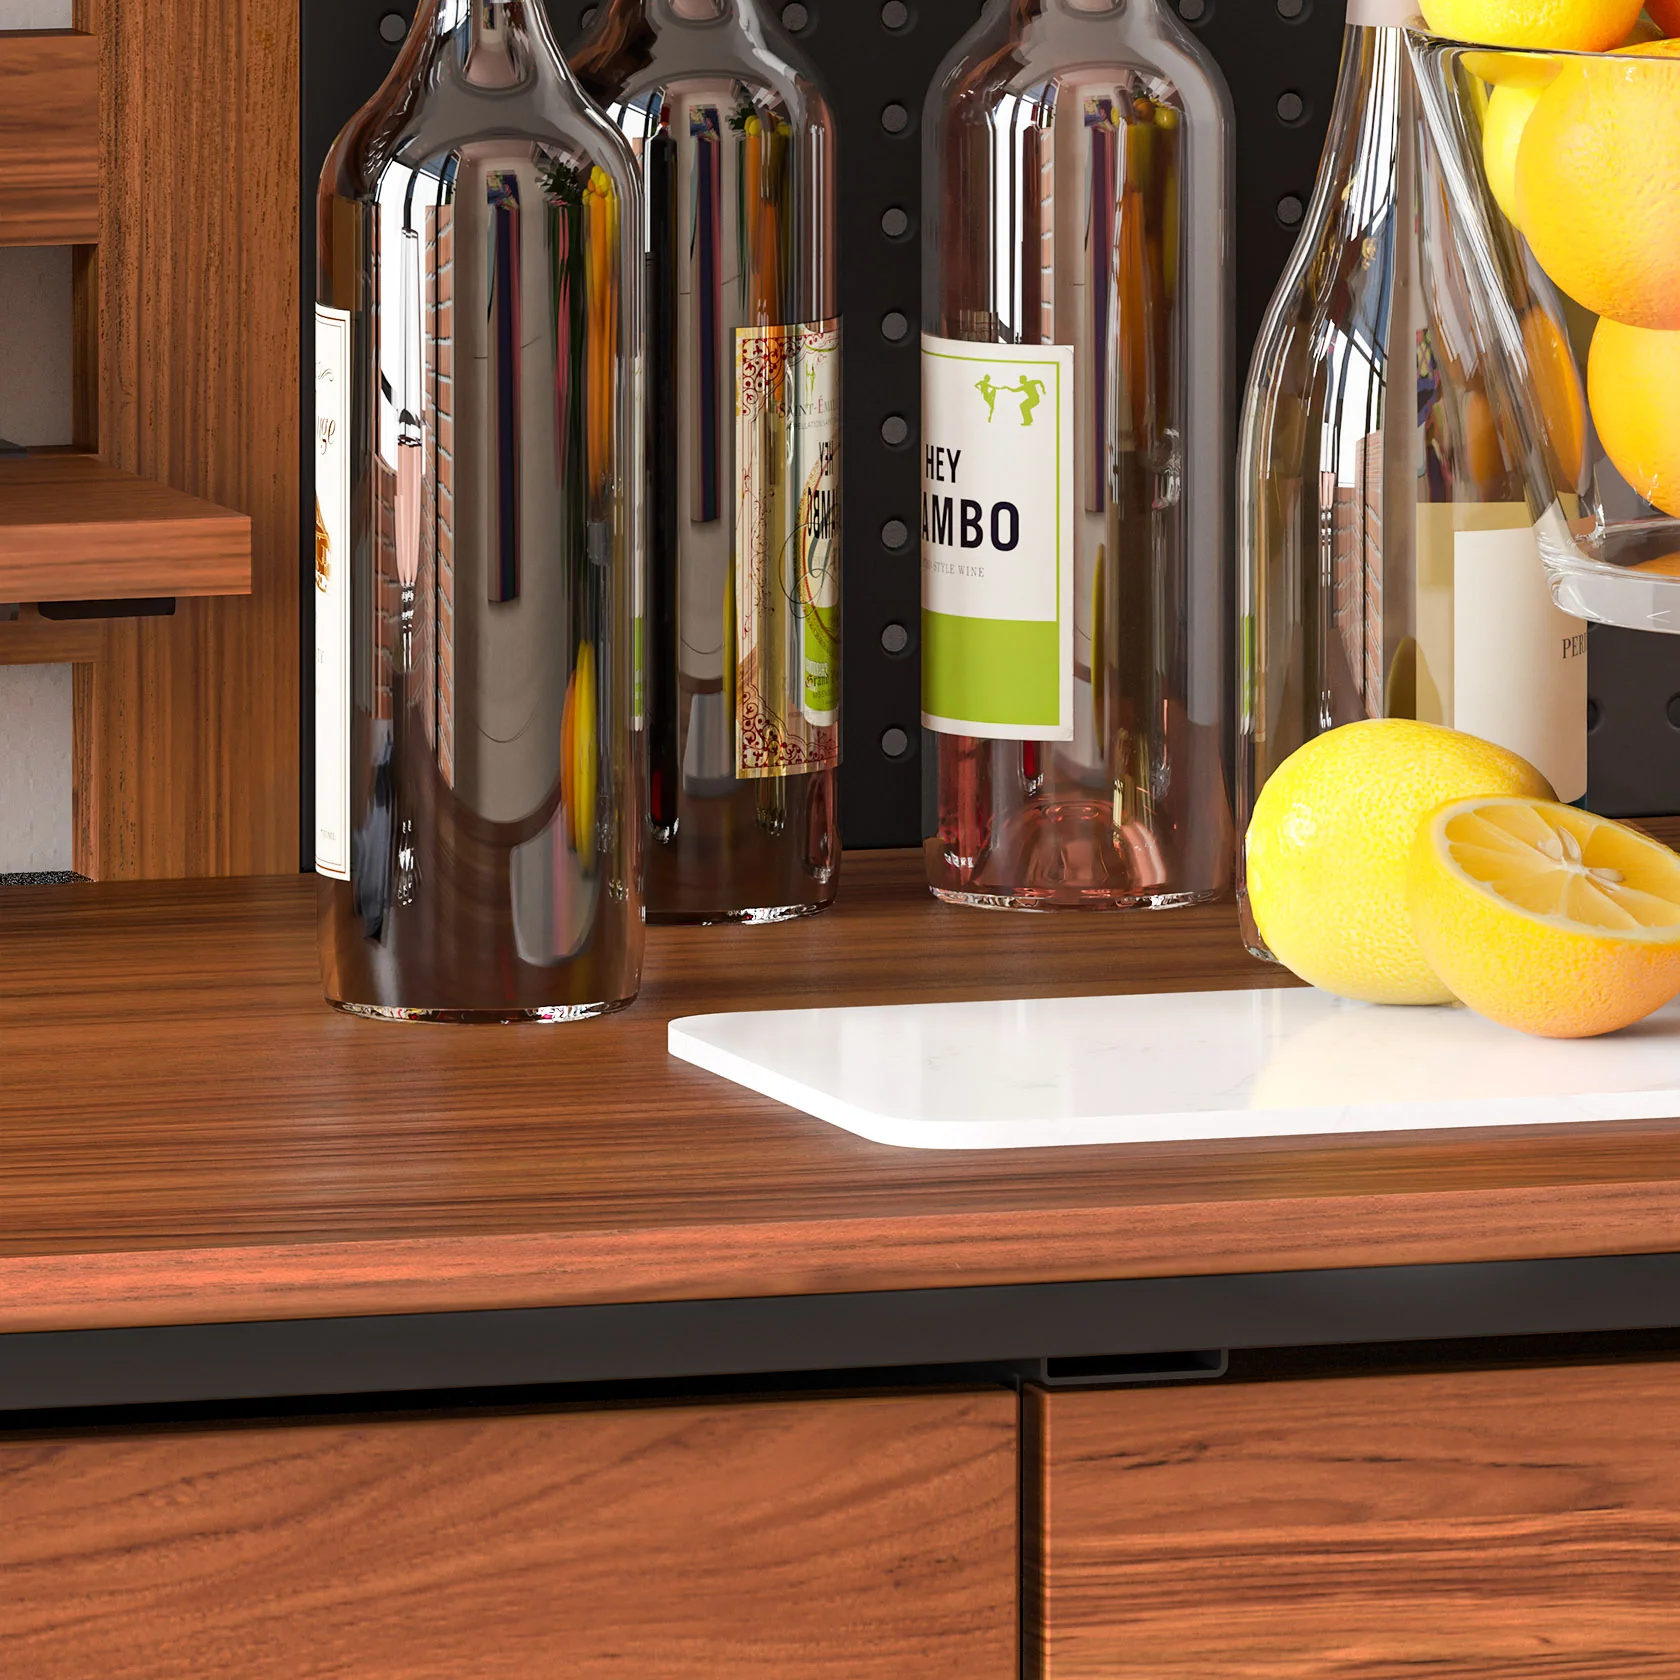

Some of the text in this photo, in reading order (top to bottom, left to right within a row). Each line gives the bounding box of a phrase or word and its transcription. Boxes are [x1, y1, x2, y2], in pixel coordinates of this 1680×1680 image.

[925, 443, 962, 484] HEY
[920, 488, 1020, 552] AMBO
[933, 560, 956, 575] STYLE
[958, 564, 985, 578] WINE
